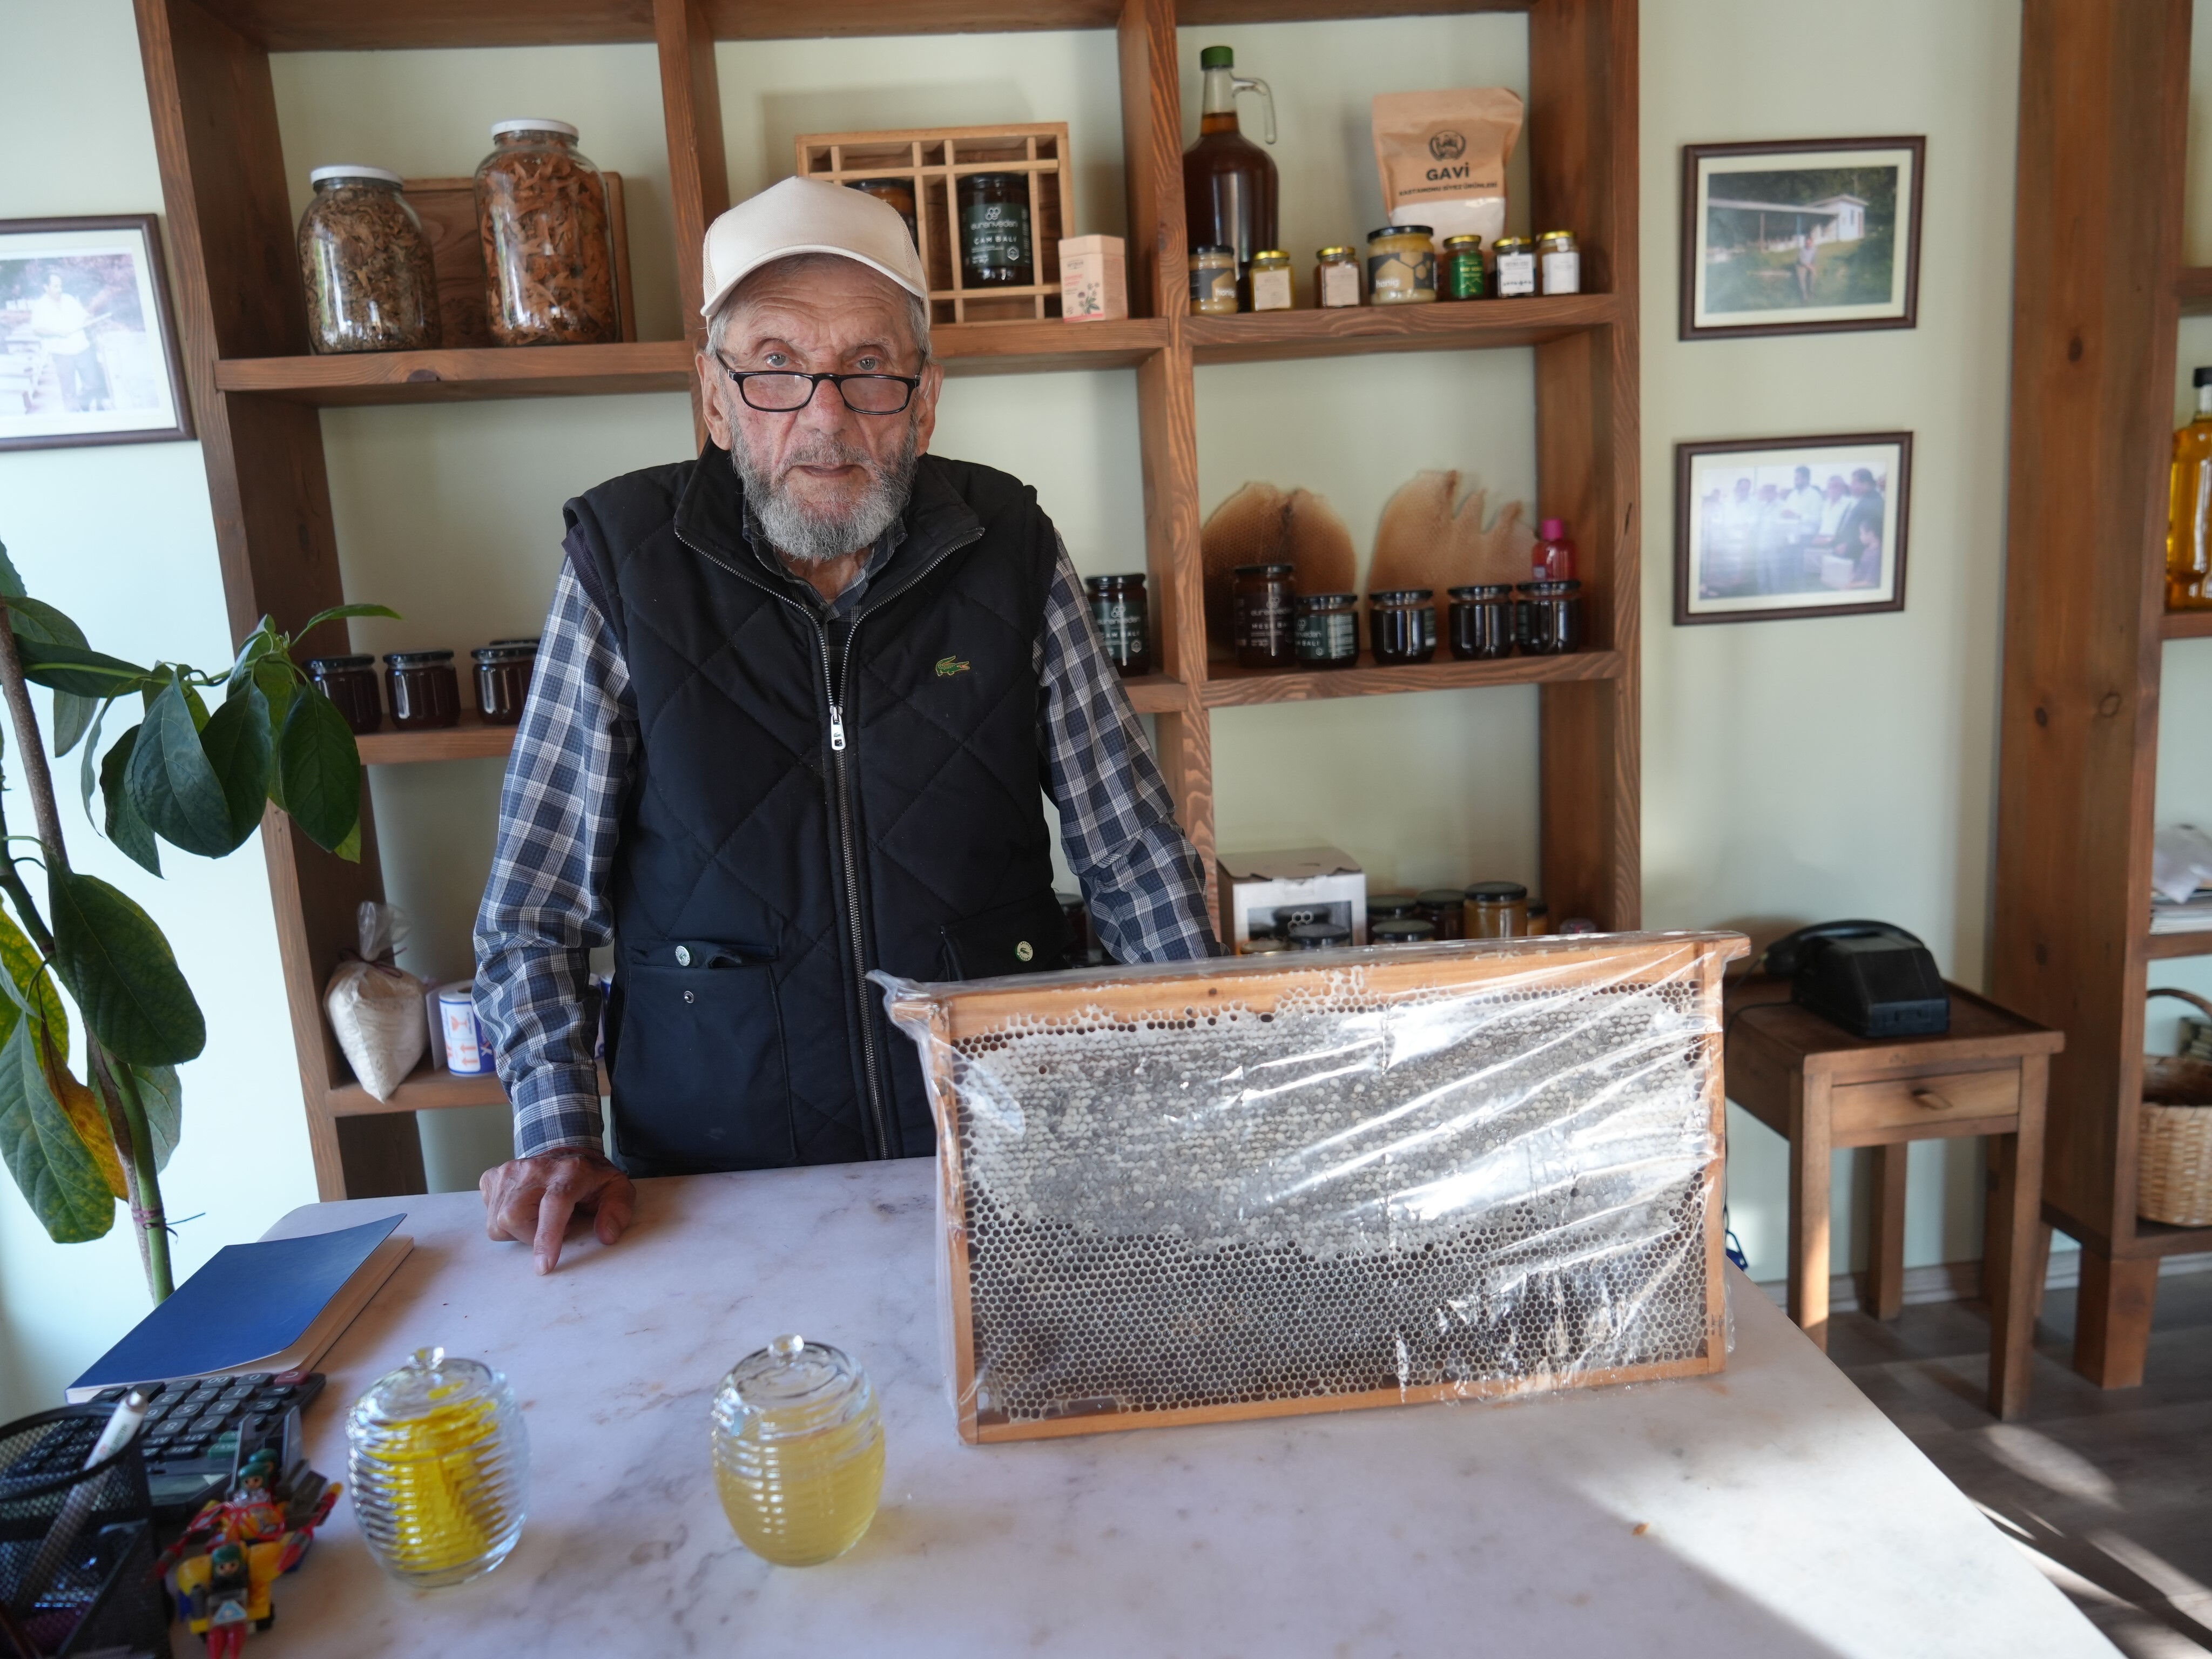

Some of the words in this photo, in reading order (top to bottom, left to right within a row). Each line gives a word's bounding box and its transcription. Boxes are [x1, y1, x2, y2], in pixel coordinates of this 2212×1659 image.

[1426, 162, 1469, 181] GAVİ
[197, 1391, 211, 1399] 2
[233, 1388, 242, 1396] 1
[161, 1394, 175, 1402] 3
[182, 1404, 195, 1413] 5
[217, 1403, 231, 1411] 4
[145, 1409, 159, 1418] 6
[164, 1421, 178, 1431] 8
[201, 1419, 214, 1427] 7
